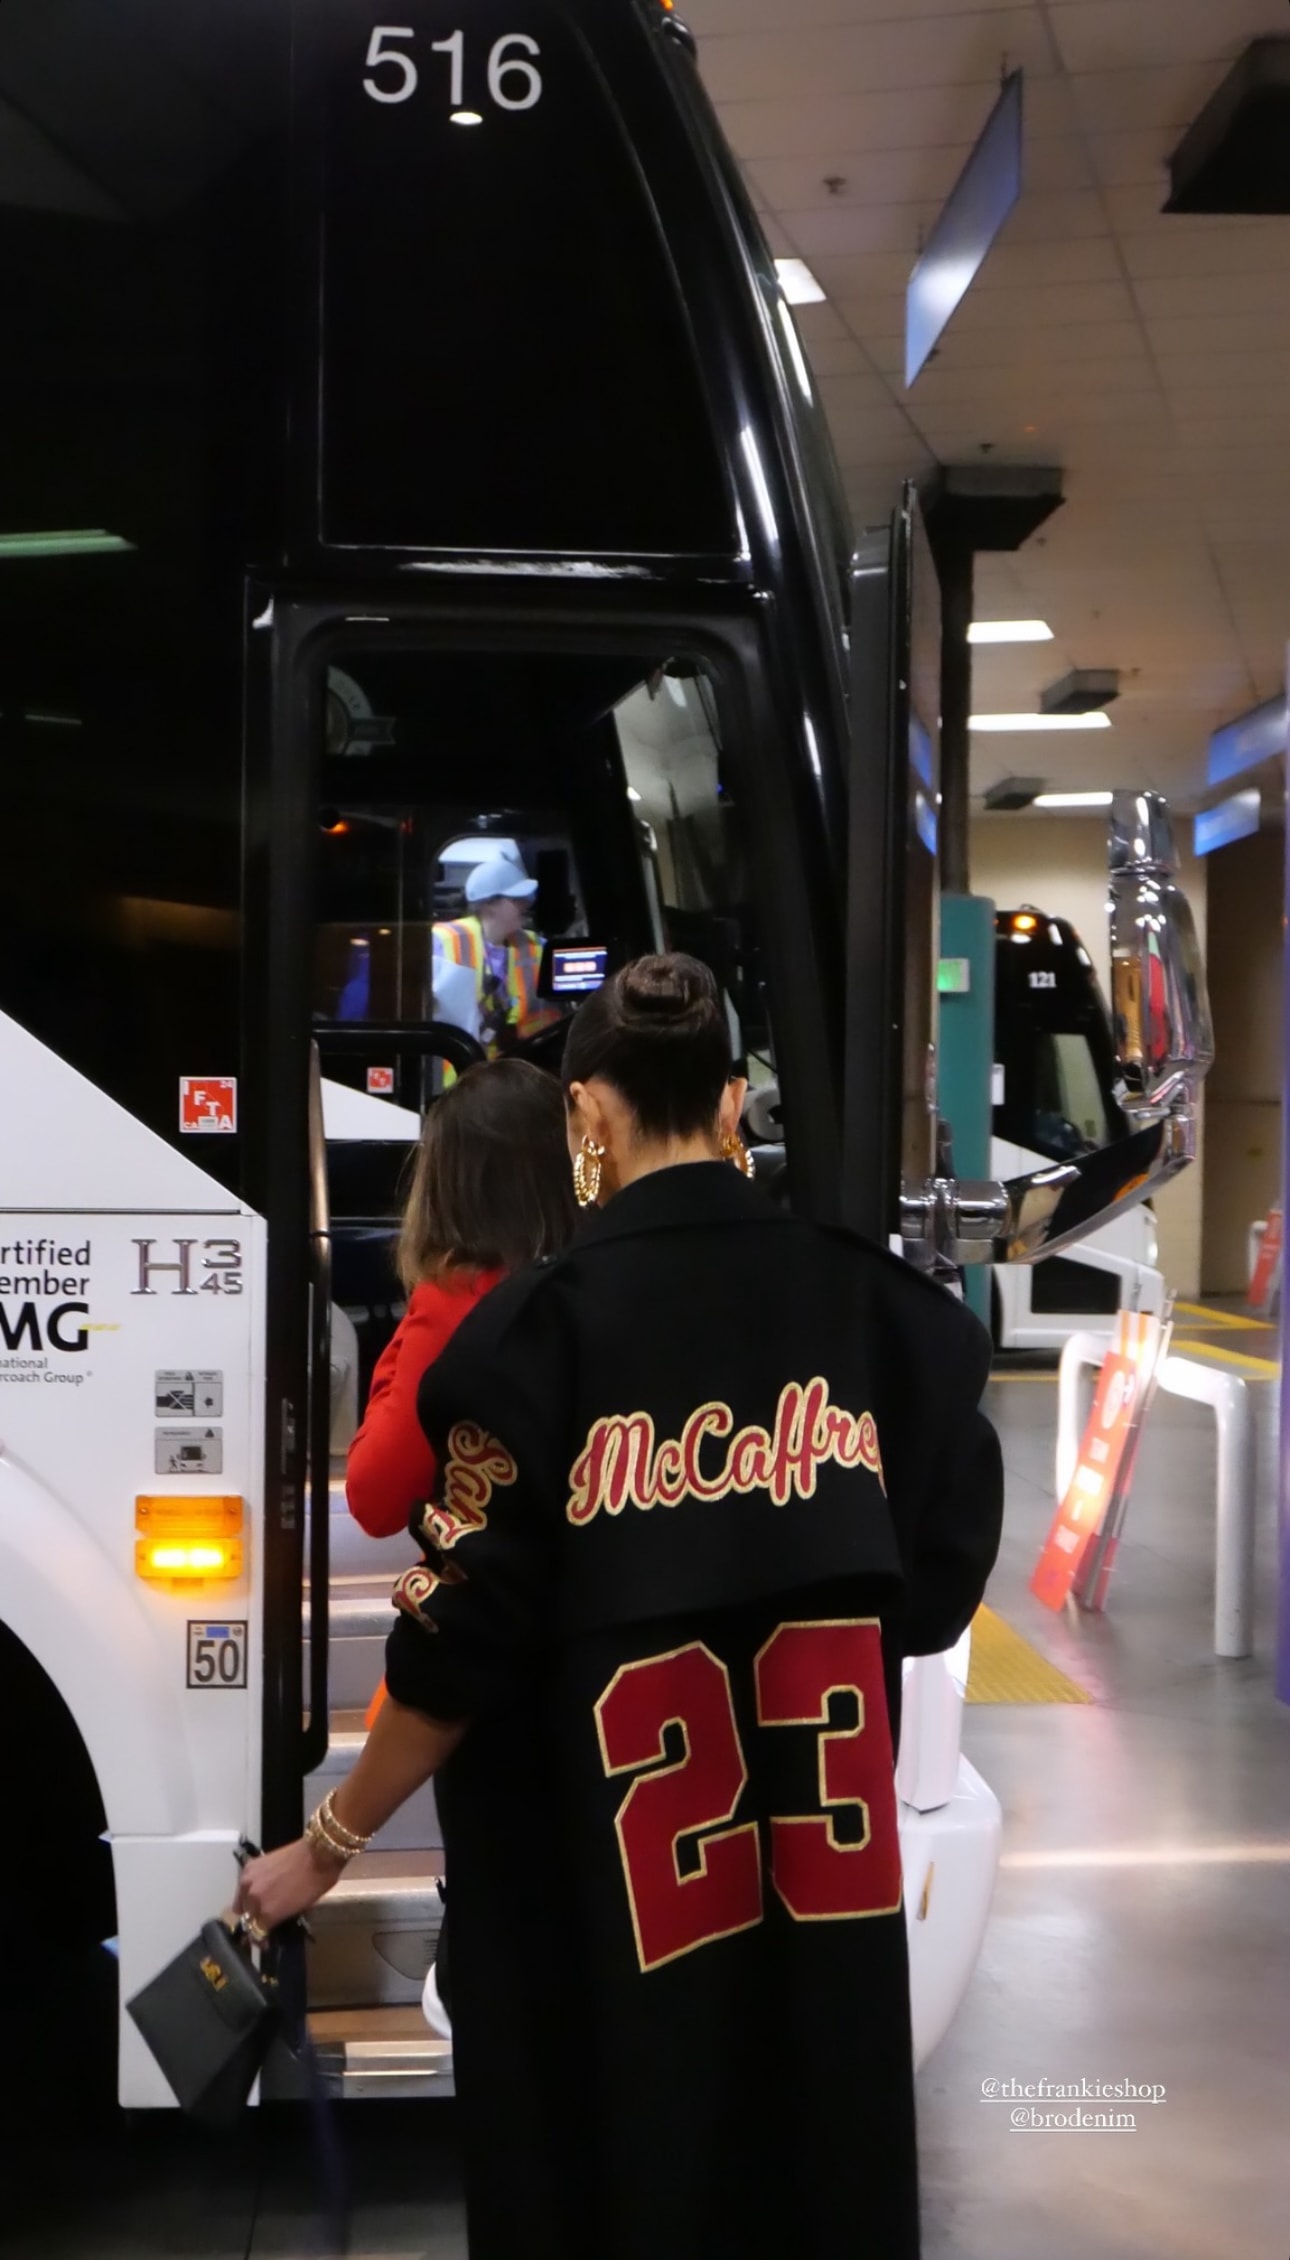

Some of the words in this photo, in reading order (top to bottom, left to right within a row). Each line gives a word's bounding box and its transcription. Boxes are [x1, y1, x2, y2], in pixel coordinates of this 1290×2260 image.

[363, 26, 542, 110] 516
[1028, 971, 1057, 988] 121
[0, 1239, 91, 1266] rtified
[0, 1269, 90, 1296] ember
[0, 1302, 89, 1352] MG
[43, 1372, 84, 1387] Group
[566, 1376, 887, 1526] McCaffre
[194, 1639, 240, 1683] 50
[593, 1617, 902, 1973] 23
